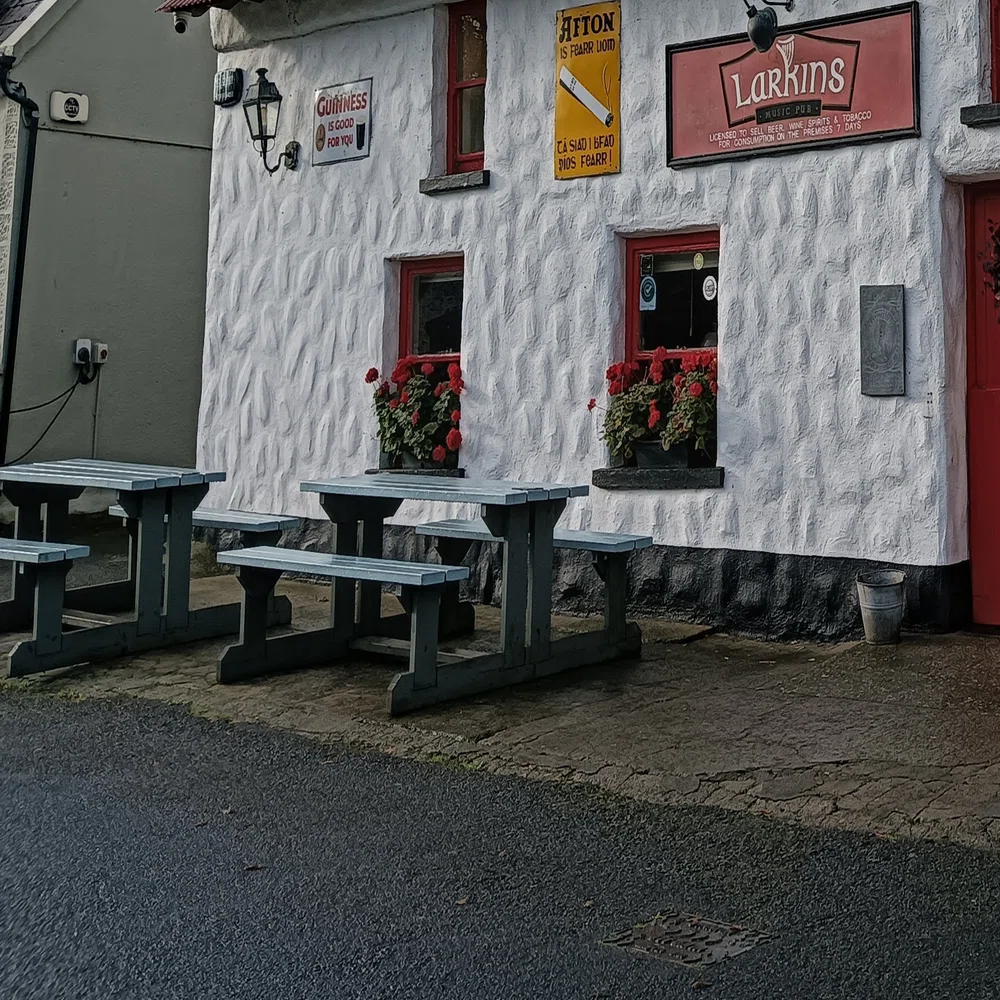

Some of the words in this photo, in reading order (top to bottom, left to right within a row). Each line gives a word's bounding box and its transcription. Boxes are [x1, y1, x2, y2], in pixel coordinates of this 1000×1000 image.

[559, 12, 615, 43] AFTON
[560, 46, 568, 59] IS
[731, 36, 845, 109] Larkins
[317, 92, 368, 117] GUINNESS
[765, 107, 791, 119] MUSIC
[795, 104, 812, 115] PUB
[328, 121, 334, 132] IS
[335, 118, 354, 131] GOOD
[709, 130, 737, 142] LICENSED
[739, 129, 748, 137] TO
[750, 127, 764, 136] SELL
[808, 117, 831, 128] SPIRITS
[833, 115, 839, 124] &
[842, 110, 872, 123] TOBACCO
[719, 140, 731, 149] FOR
[733, 132, 775, 147] CONSUMPTION
[777, 132, 785, 141] ON
[788, 129, 800, 139] THE
[803, 125, 833, 137] PREMISES
[836, 124, 841, 133] 7
[845, 120, 862, 132] DAYS
[328, 137, 340, 148] FOR
[341, 134, 354, 146] YOU
